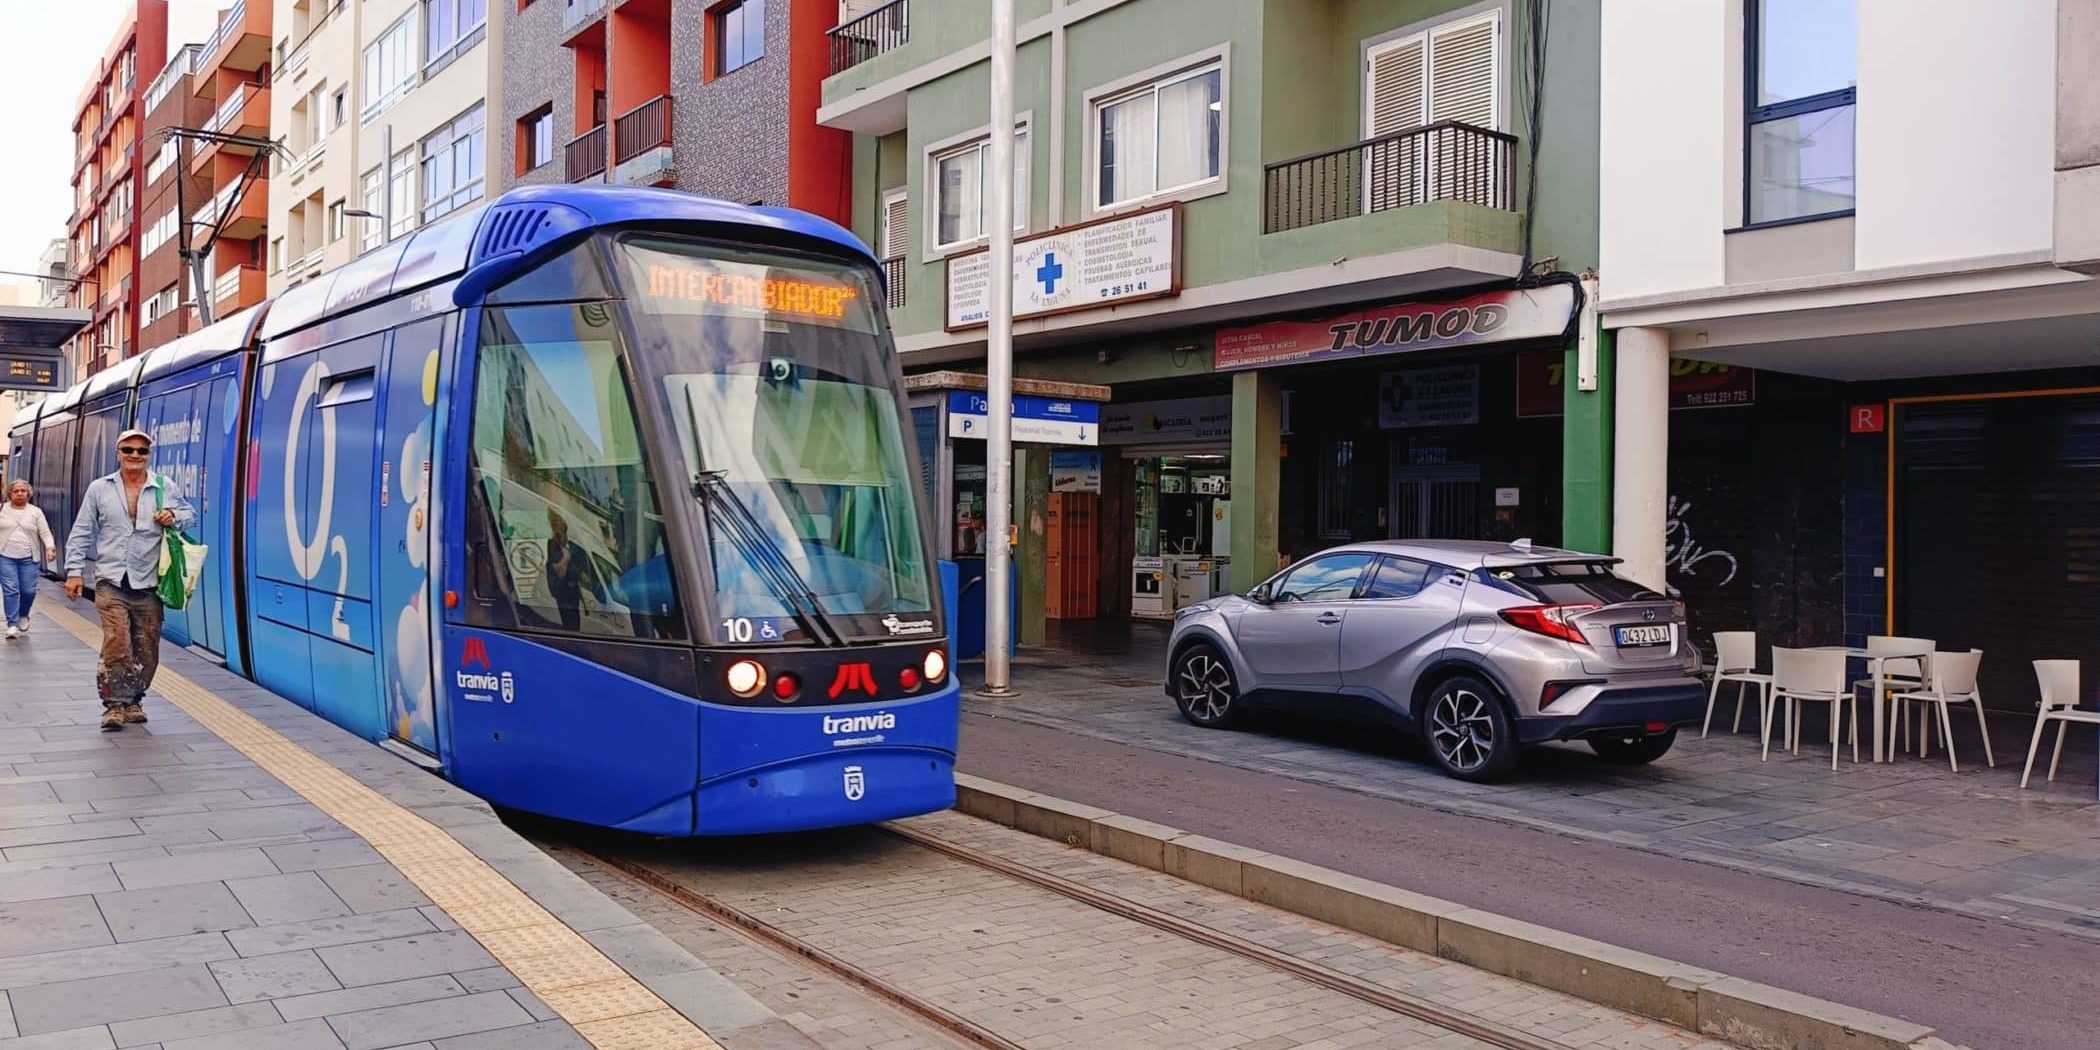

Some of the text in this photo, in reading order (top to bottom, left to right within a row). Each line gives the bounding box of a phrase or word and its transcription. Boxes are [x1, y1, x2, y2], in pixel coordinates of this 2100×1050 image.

[1136, 212, 1168, 226] FAMILIAR
[1084, 227, 1147, 248] ENFERMEDADES DE
[1131, 236, 1158, 248] SEXUAL
[1025, 240, 1073, 266] POLICLINICA
[1084, 250, 1134, 266] COSMETOLOGIA
[1084, 255, 1153, 275] PRUEBAS ALERGICAS
[1084, 270, 1132, 285] TRATAMIENTOS
[649, 264, 845, 319] INTERCAMBIADOR
[1112, 281, 1147, 296] 26 51 41
[1328, 303, 1510, 352] TUMOD
[963, 420, 972, 432] P
[1858, 409, 1874, 428] R
[723, 618, 752, 642] 10
[823, 711, 896, 735] tranvía
